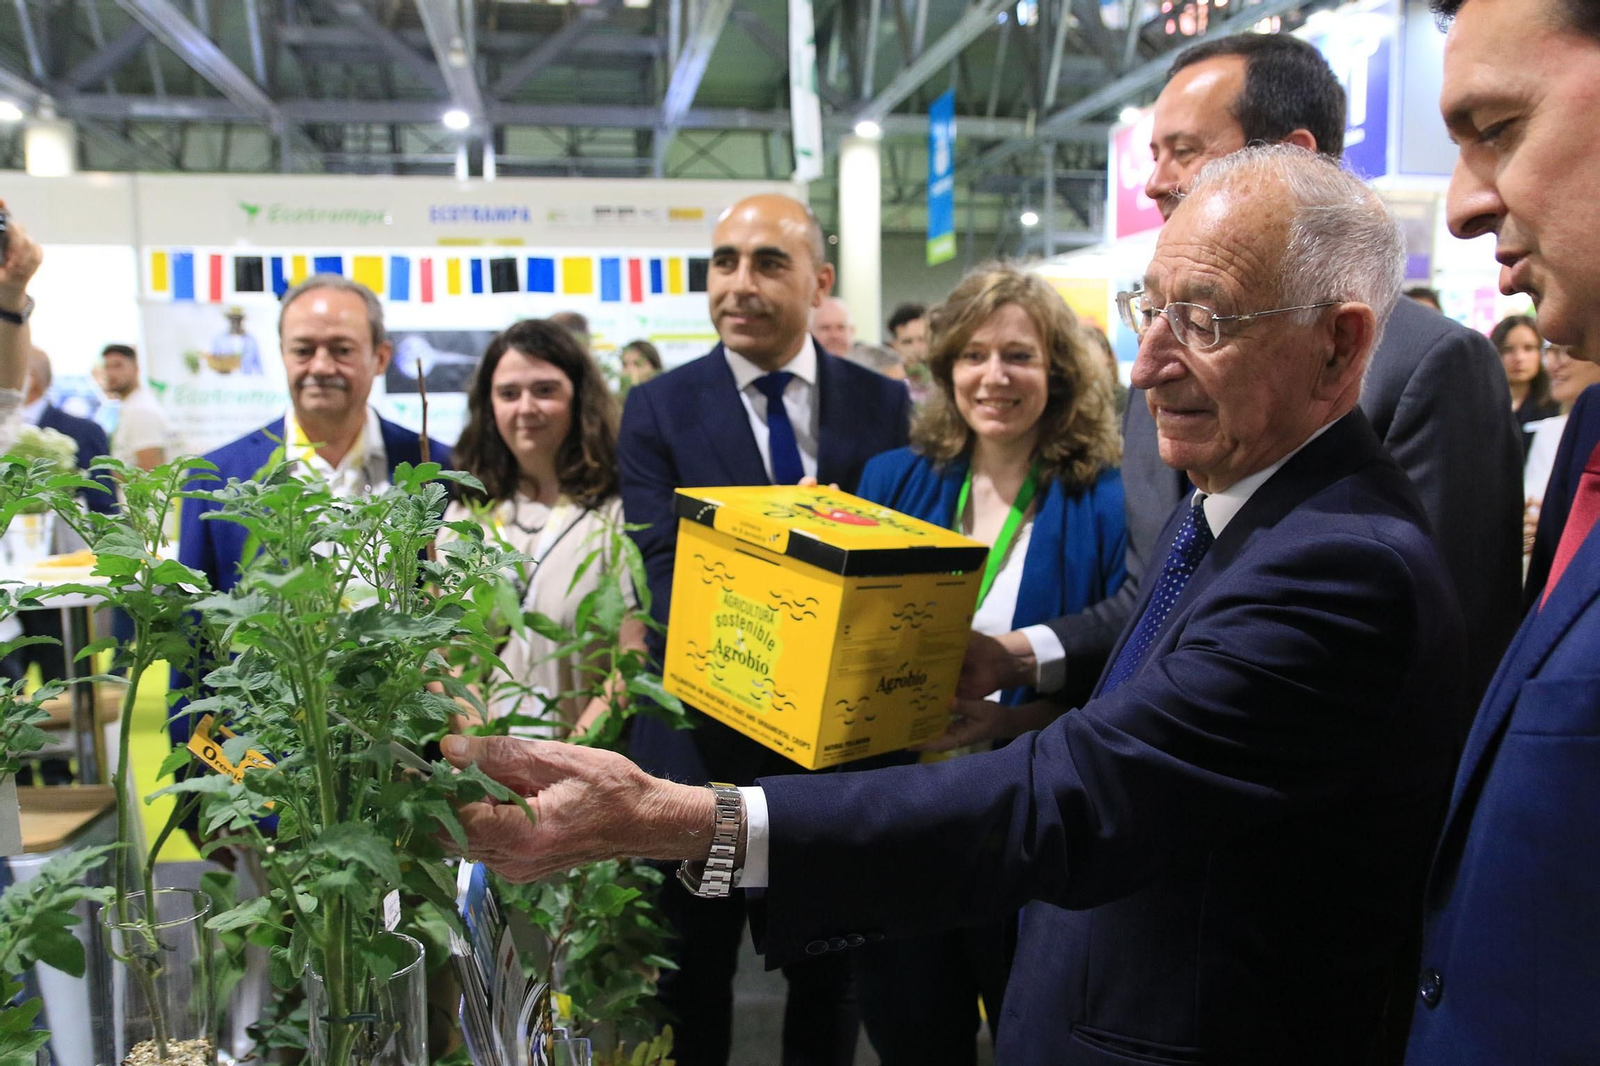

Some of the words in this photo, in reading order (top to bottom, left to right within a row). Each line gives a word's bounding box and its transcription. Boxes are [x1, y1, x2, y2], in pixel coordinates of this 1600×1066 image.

[428, 204, 531, 223] ECOTRAMPA
[723, 594, 774, 624] AGRICULTURA
[715, 614, 776, 652] sostenible
